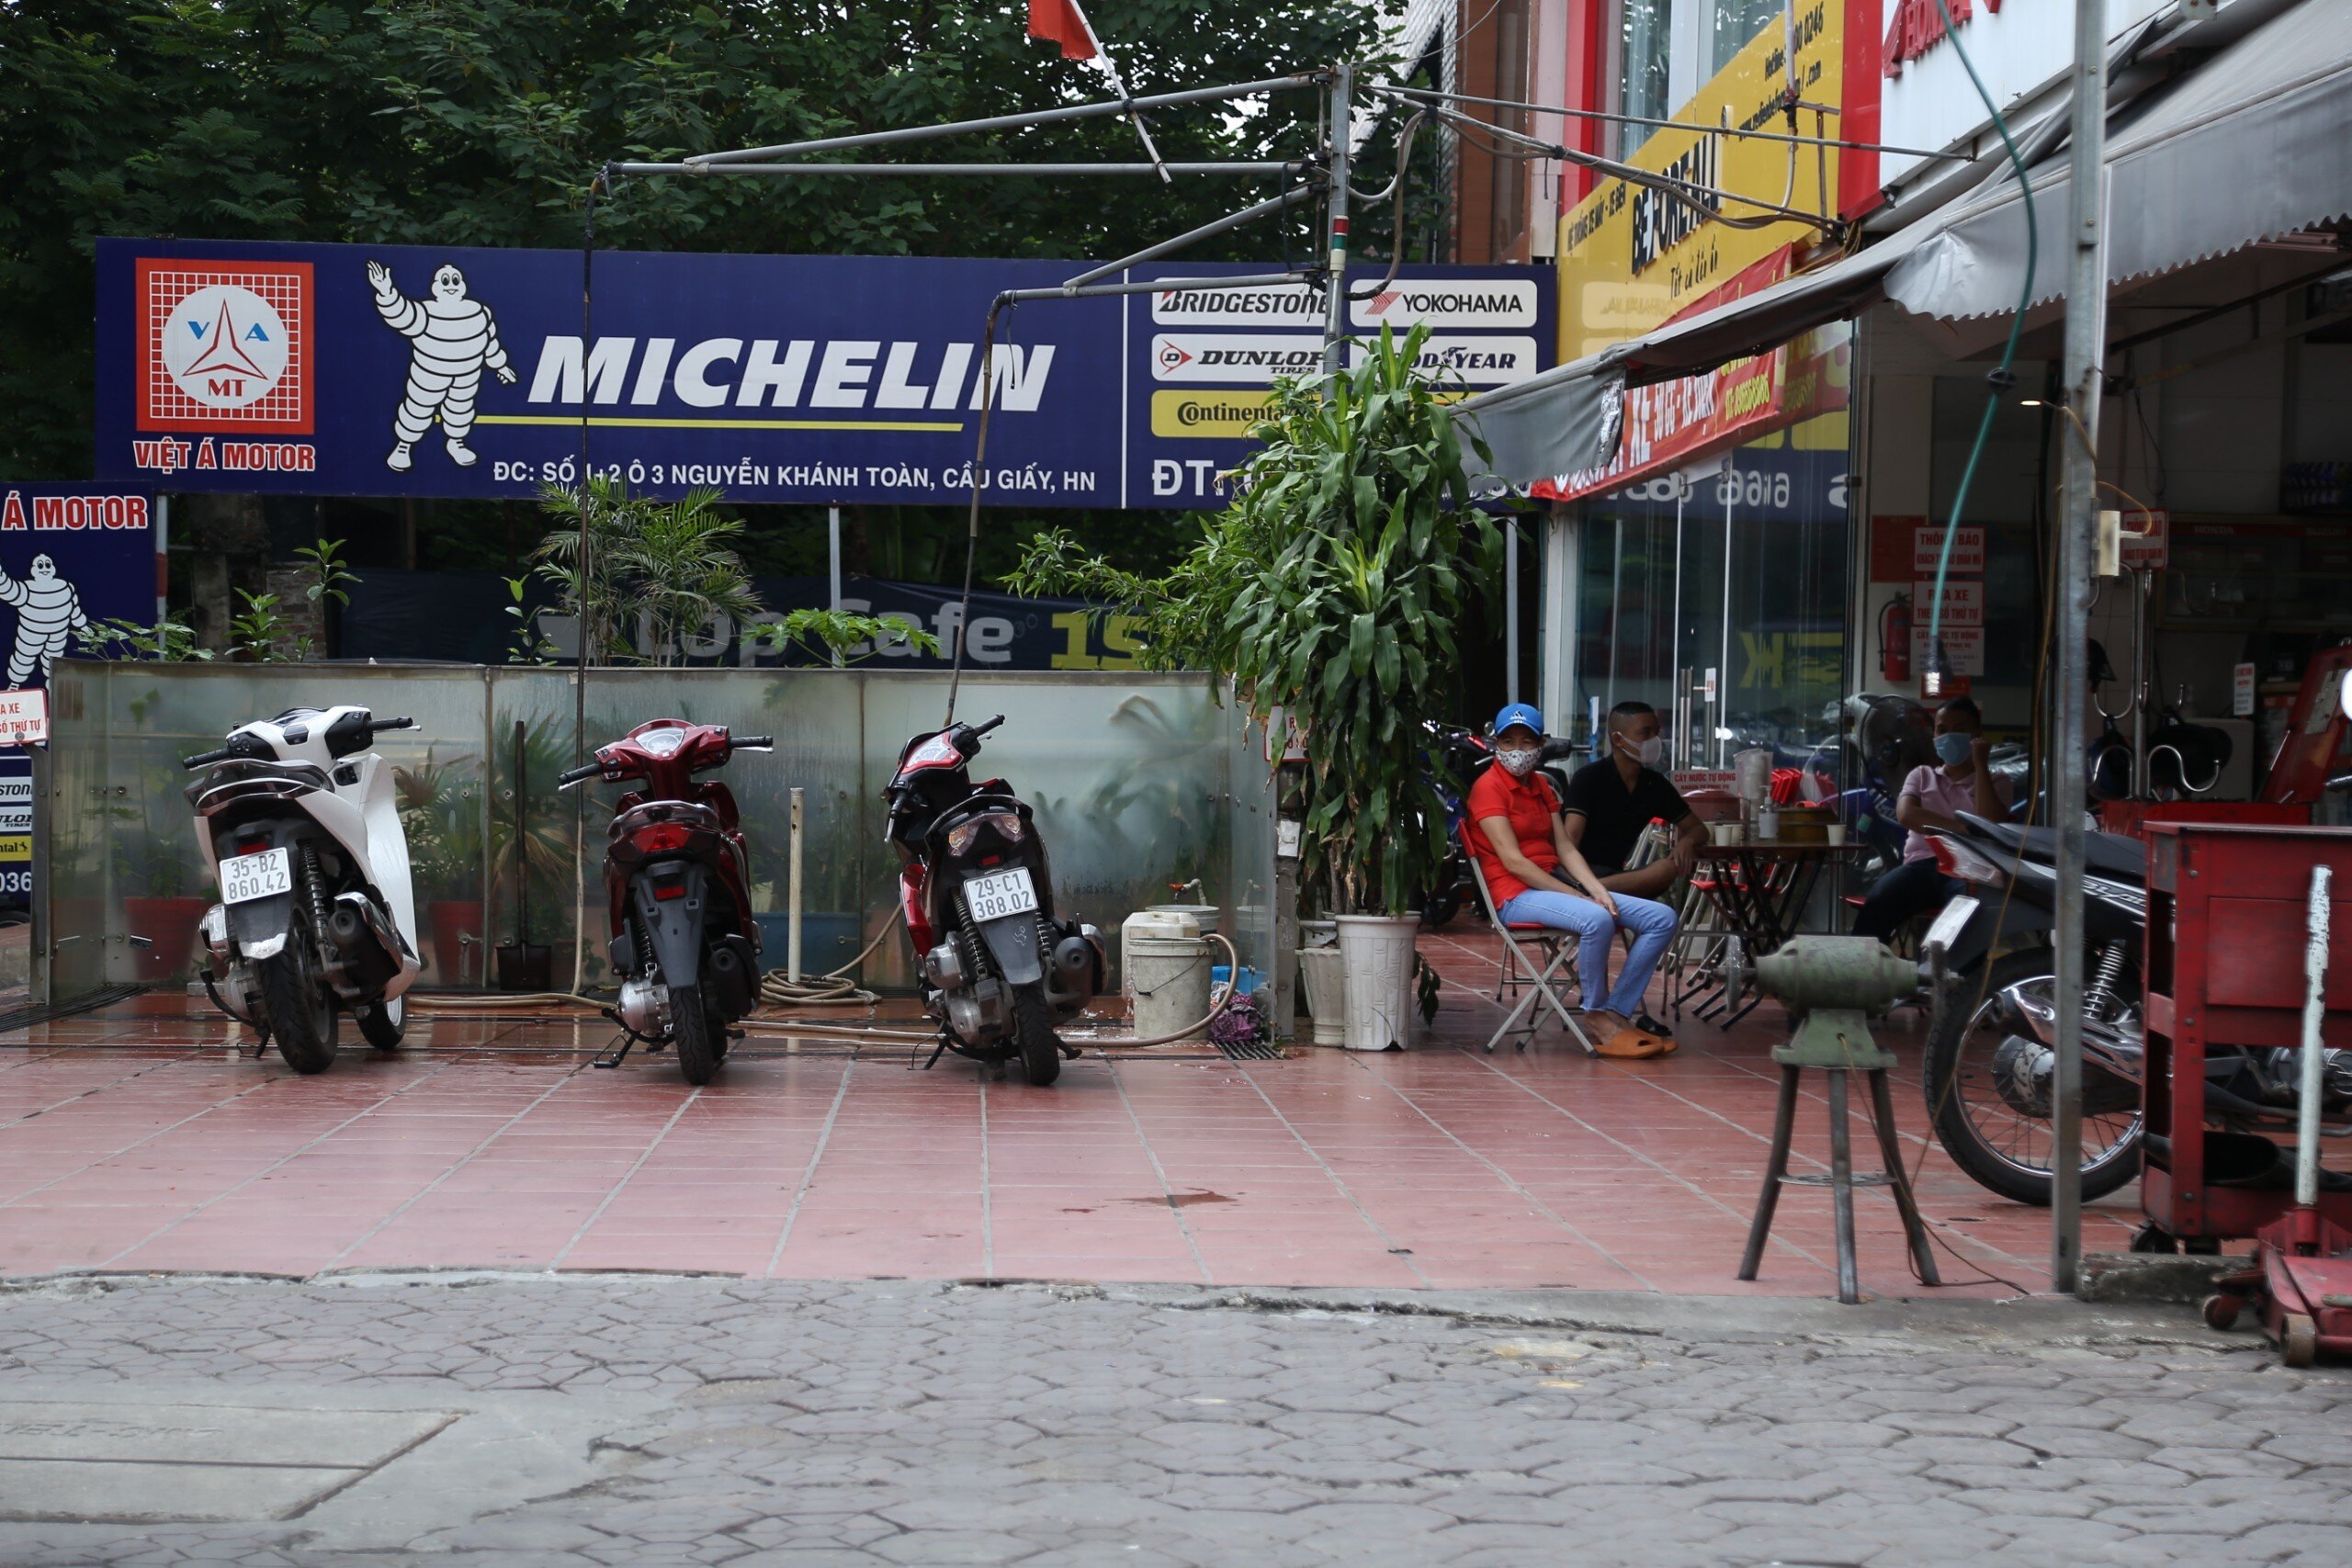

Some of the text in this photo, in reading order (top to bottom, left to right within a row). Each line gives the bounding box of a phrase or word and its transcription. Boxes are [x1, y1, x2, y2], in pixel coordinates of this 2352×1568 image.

[1402, 294, 1523, 313] YOKOHAMA
[1198, 350, 1324, 366] DUNLOP
[527, 335, 1056, 412] MICHELIN
[1270, 367, 1317, 375] TIRES
[208, 378, 247, 398] MT
[1177, 401, 1287, 426] Continenta
[133, 436, 315, 474] VIỆT Á MOTOR
[493, 461, 535, 482] ĐC:
[542, 454, 575, 483] SỐ
[628, 458, 645, 484] Ô
[651, 464, 664, 485] 3
[672, 457, 770, 486] NGUYỄN
[777, 461, 859, 487] KHÁNH
[866, 462, 935, 491] TOÀN,
[997, 462, 1056, 493] GIẤY,
[1063, 471, 1095, 491] HN
[2, 491, 149, 531] Á MOTOR
[1954, 588, 1970, 601] XE
[8, 703, 20, 715] XE
[10, 718, 28, 733] THỨ
[29, 718, 41, 734] TỰ
[231, 852, 278, 879] 35-B2
[228, 871, 287, 899] 860.42
[975, 873, 1022, 898] 29-C1
[975, 890, 1033, 919] 388.02
